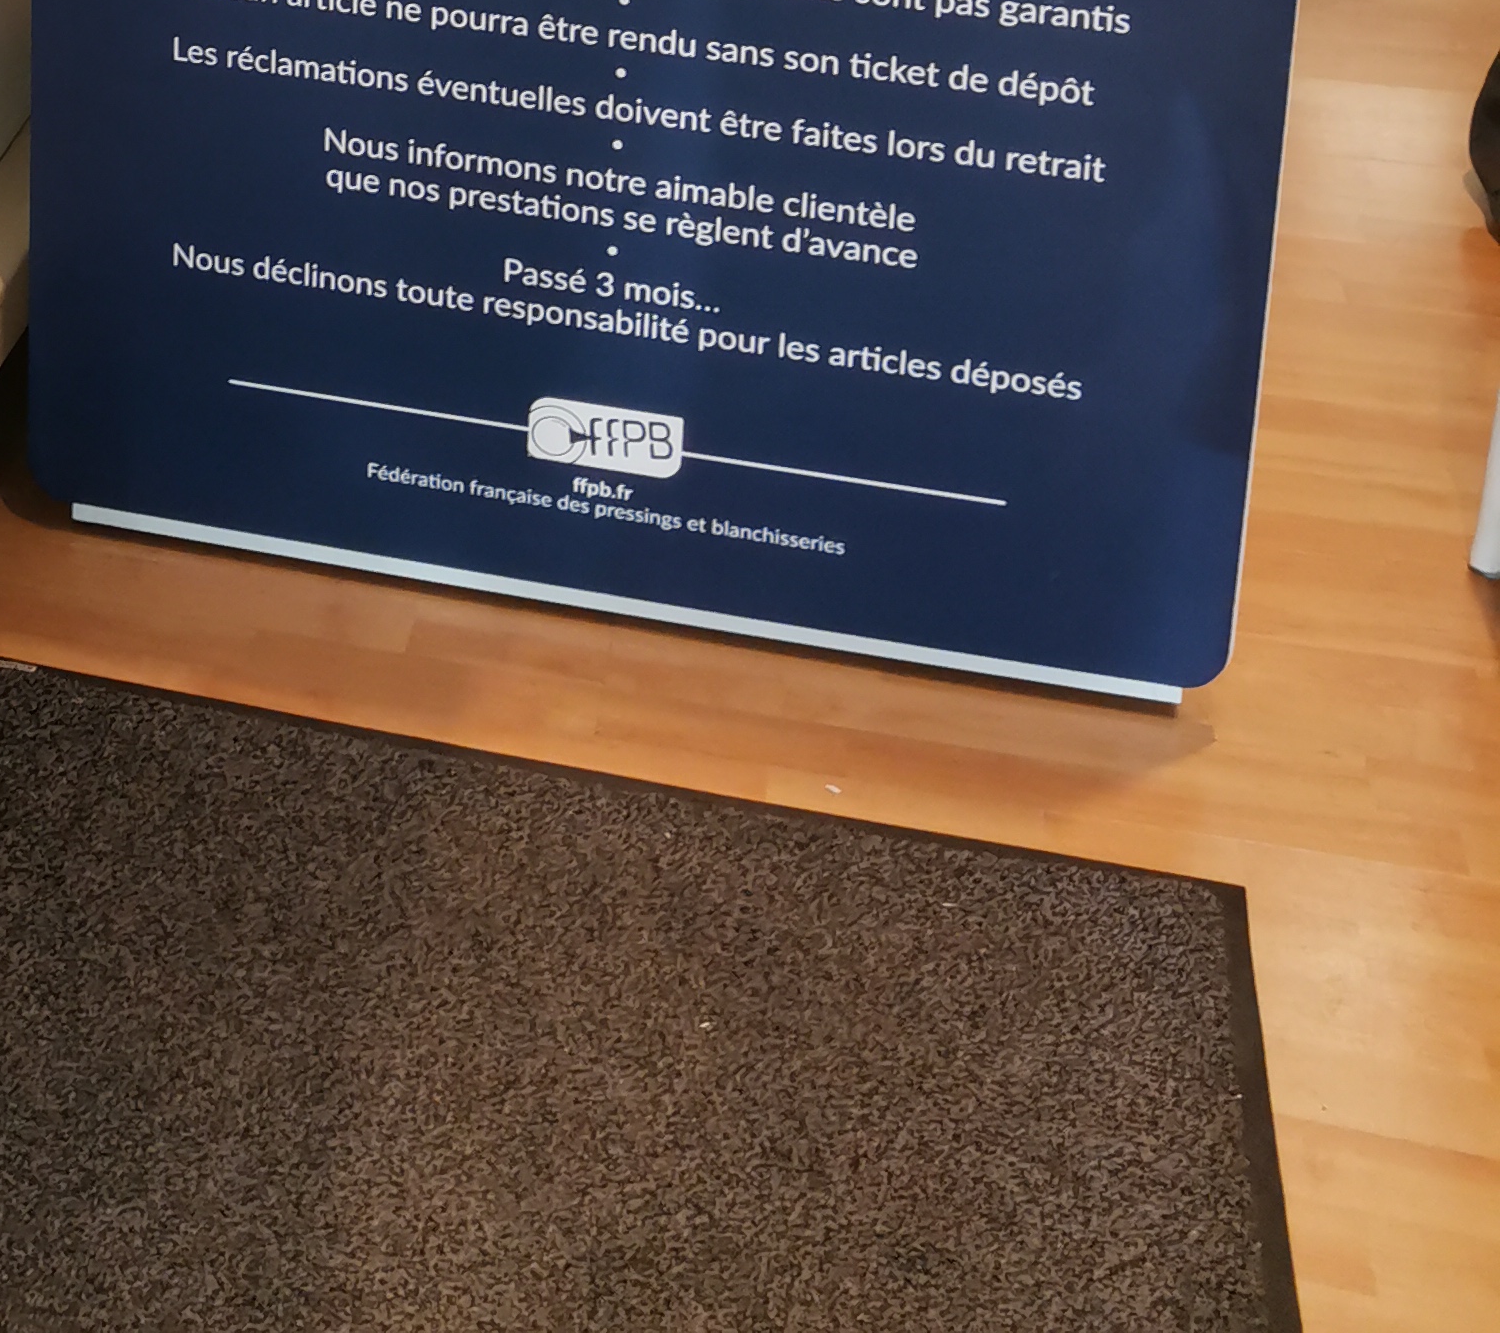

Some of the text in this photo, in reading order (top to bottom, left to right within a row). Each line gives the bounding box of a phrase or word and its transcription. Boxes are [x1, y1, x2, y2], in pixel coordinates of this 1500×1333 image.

[998, 0, 1131, 35] garantis
[172, 35, 1107, 184] Les réclamations éventuelles doivent être faites lors du retrait
[323, 126, 917, 233] Nous informons notre aimable clientèle
[172, 242, 1083, 401] Nous déclinons toute responsabilité pour les articles déposés
[503, 257, 588, 294] Passé
[594, 271, 615, 298] 3
[366, 461, 846, 556] Fédération française des pressings et blanchisseries
[571, 476, 635, 502] ffpb.fr
